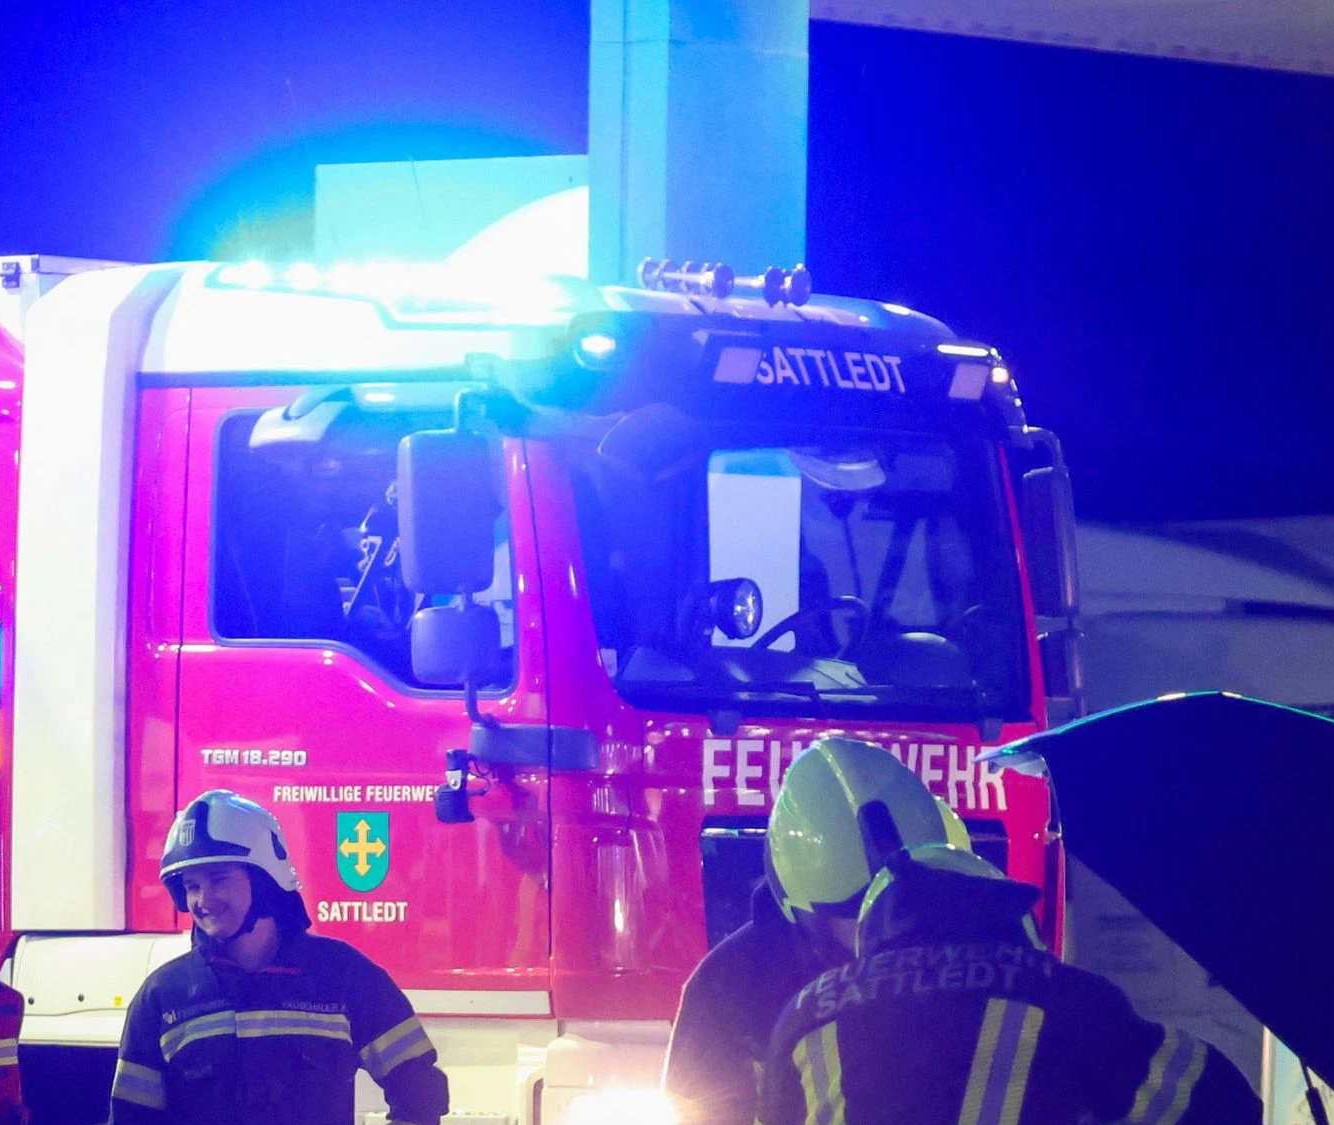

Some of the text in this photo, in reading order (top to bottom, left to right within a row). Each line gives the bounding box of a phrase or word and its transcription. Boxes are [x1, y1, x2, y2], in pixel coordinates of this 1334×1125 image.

[756, 346, 906, 393] SATTLEDT
[201, 749, 308, 767] TGM 18.290
[273, 785, 440, 803] FREIWILLIGE FEUERWE
[317, 900, 408, 922] SATTLEDT
[815, 961, 1023, 1018] SATTLEDT
